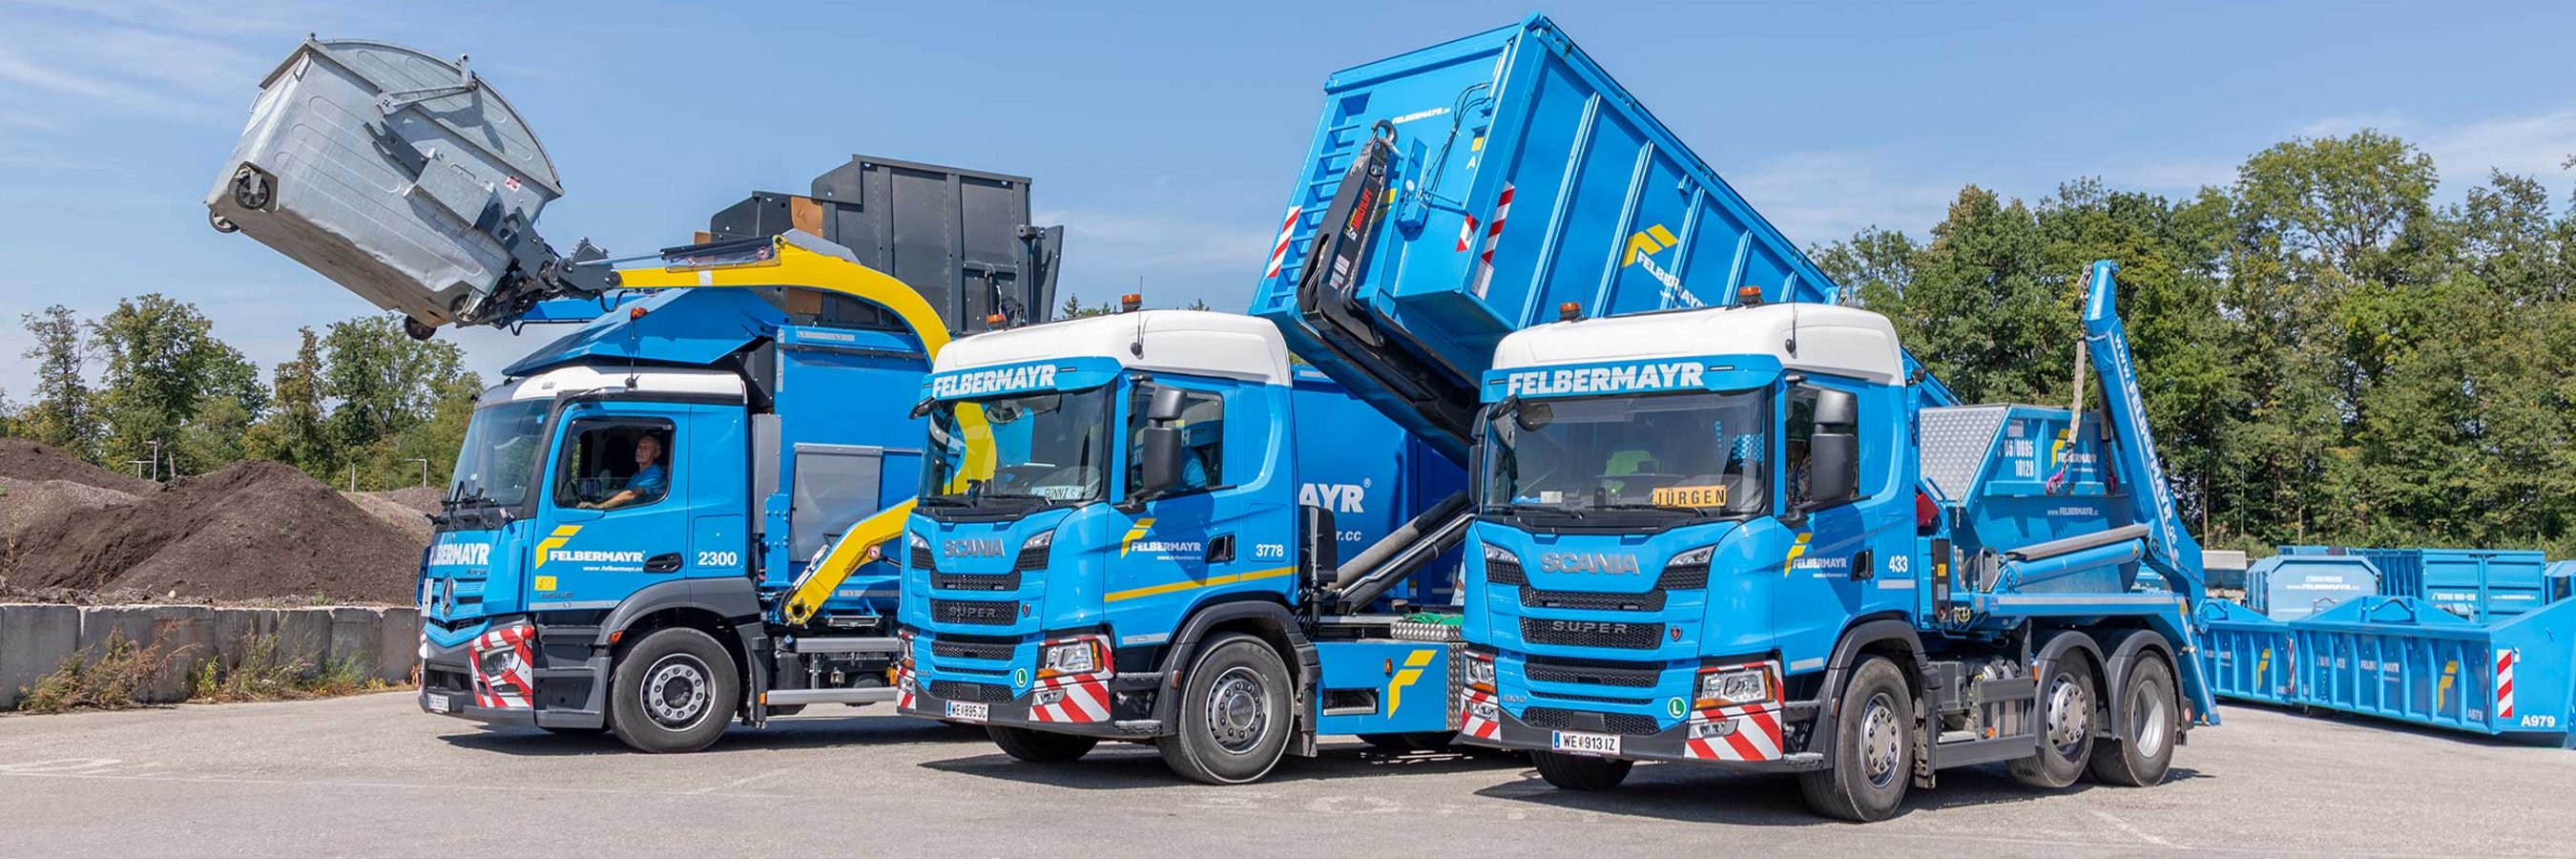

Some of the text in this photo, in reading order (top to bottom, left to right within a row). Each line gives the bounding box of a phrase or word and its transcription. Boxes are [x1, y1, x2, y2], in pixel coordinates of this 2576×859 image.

[932, 364, 1056, 398] FELBERMAYR
[1507, 362, 1704, 396] FELBERMAYR
[1654, 488, 1725, 506] JÜRGEN
[944, 537, 1006, 558] SCANIA
[1131, 541, 1202, 552] FELBERMAYR
[1256, 543, 1284, 557] 3778
[550, 550, 643, 562] FELBERMAYR
[697, 551, 737, 566] 2300
[1793, 557, 1848, 569] FELBERMAYR
[1541, 552, 1640, 576] SCANIA
[1888, 555, 1908, 573] 433
[948, 605, 996, 618] SUPER
[1552, 620, 1628, 634] SUPER
[965, 704, 978, 718] 895
[2467, 707, 2483, 722] A979
[2521, 715, 2556, 727] A979
[1563, 735, 1615, 751] WE 913 IZ
